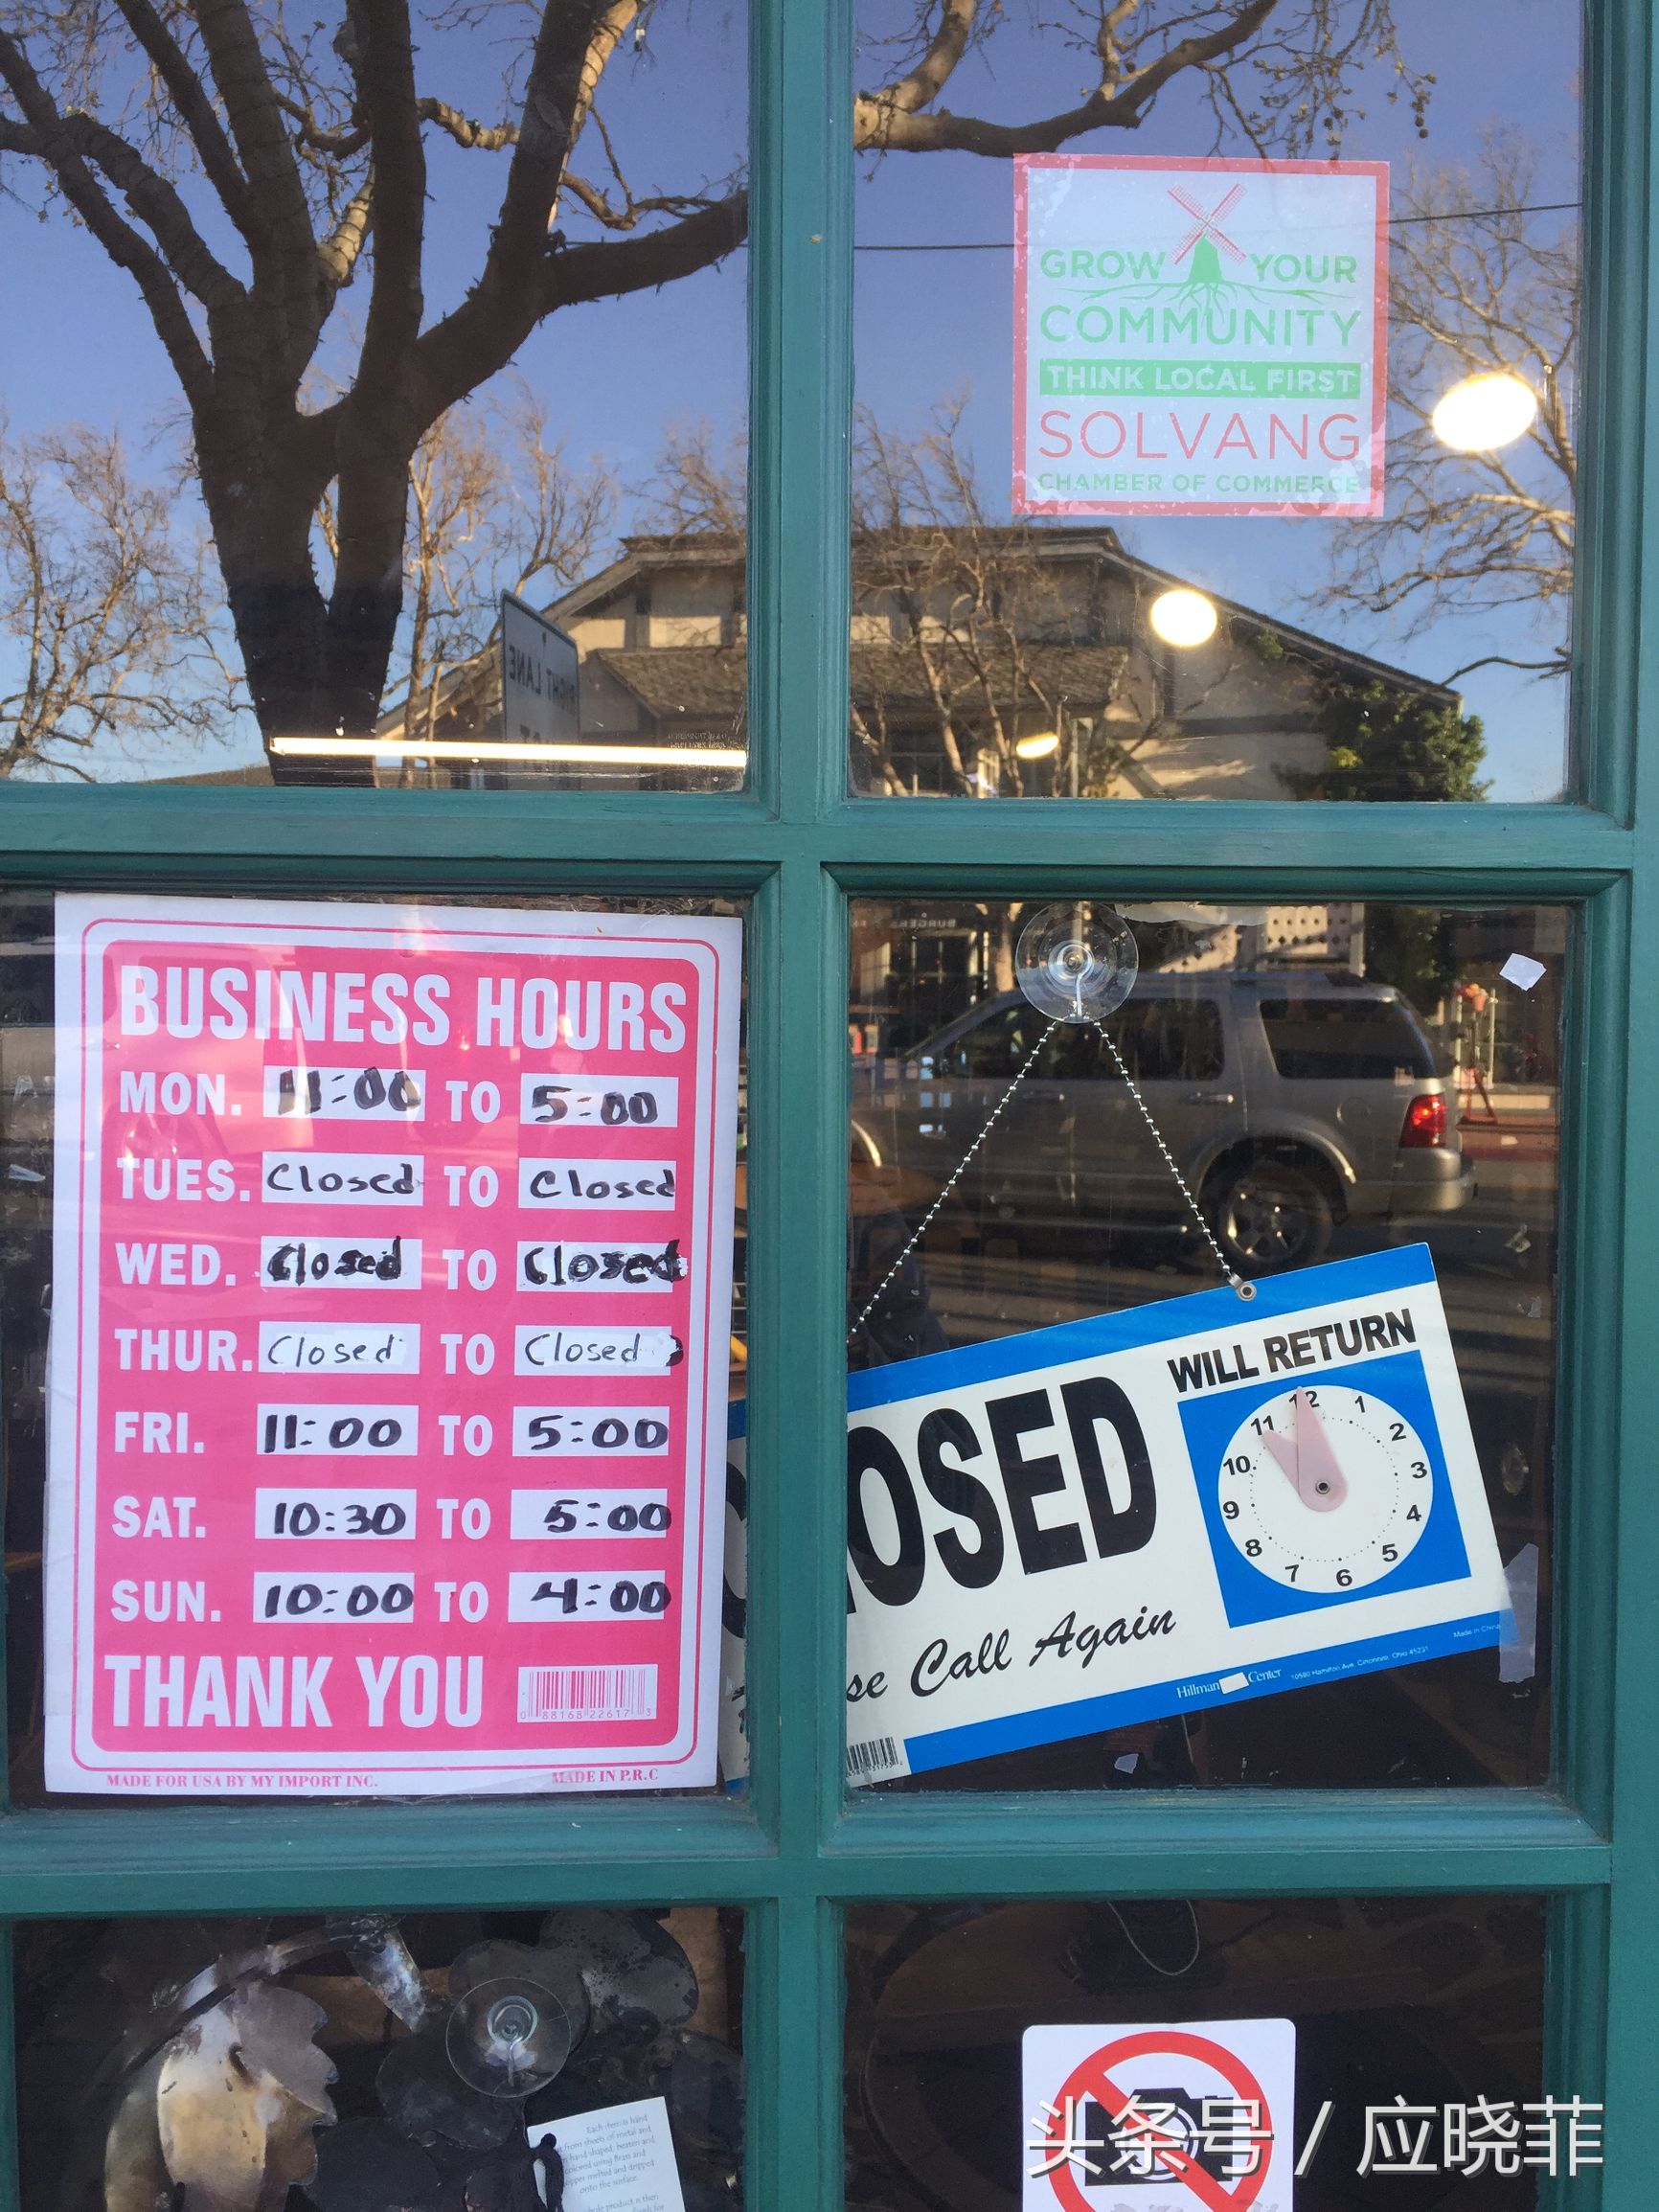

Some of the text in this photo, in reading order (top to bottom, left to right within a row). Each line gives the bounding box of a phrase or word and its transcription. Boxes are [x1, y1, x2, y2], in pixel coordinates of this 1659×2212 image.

[1039, 249, 1358, 284] GROW YOUR
[1039, 305, 1361, 347] COMMUNITY
[1047, 365, 1359, 394] THINK LOCAL FIRST
[1038, 410, 1361, 462] SOLVANG
[1037, 472, 1359, 494] CHAMBER OF COMMERCE
[120, 965, 688, 1054] BUSINESS HOURS
[120, 1071, 242, 1116] MON.
[278, 1065, 422, 1116] 11:00
[445, 1080, 502, 1124] TO
[531, 1084, 659, 1126] 5:00
[116, 1157, 251, 1202] TUES.
[266, 1162, 416, 1195] Closed
[443, 1164, 499, 1208] TO
[529, 1169, 677, 1199] Closed
[114, 1243, 237, 1287] WED.
[266, 1235, 403, 1287] Closed
[442, 1248, 497, 1291] TO
[523, 1239, 687, 1287] Closed
[114, 1328, 253, 1373] THUR.
[267, 1334, 395, 1368] Closed
[441, 1333, 495, 1377] TO
[524, 1332, 641, 1366] Closed
[1167, 1308, 1418, 1393] WILL RETURN
[1354, 1396, 1367, 1413] 1
[114, 1411, 205, 1454] FRI.
[264, 1413, 402, 1453] 11:00
[438, 1415, 493, 1457] TO
[528, 1414, 670, 1450] 5:00
[1250, 1415, 1275, 1436] 11
[1389, 1423, 1407, 1441] 2
[1222, 1455, 1251, 1475] 10
[1410, 1461, 1428, 1479] 3
[847, 1377, 1157, 1613] OSED
[1222, 1500, 1240, 1519] 9
[1406, 1504, 1422, 1522] 4
[112, 1495, 207, 1539] SAT.
[274, 1501, 407, 1536] 10:30
[437, 1498, 491, 1540] TO
[543, 1498, 671, 1532] 5:00
[1244, 1539, 1262, 1558] 8
[1381, 1543, 1398, 1562] 5
[1284, 1563, 1300, 1583] 7
[1335, 1568, 1353, 1586] 6
[111, 1580, 221, 1623] SUN.
[264, 1583, 414, 1618] 10:00
[434, 1582, 489, 1624] TO
[531, 1578, 671, 1614] 4:00
[910, 1628, 1012, 1698] Call
[1028, 1606, 1177, 1669] Again
[103, 1654, 484, 1728] THANK YOU
[1176, 1667, 1283, 1699] Hillman Center
[106, 1775, 379, 1788] MADE FOR USA BY MY IMPORT INC.
[552, 1771, 596, 1785] MADE
[600, 1770, 616, 1783] IN
[564, 2141, 582, 2152] from
[580, 2183, 598, 2194] onto
